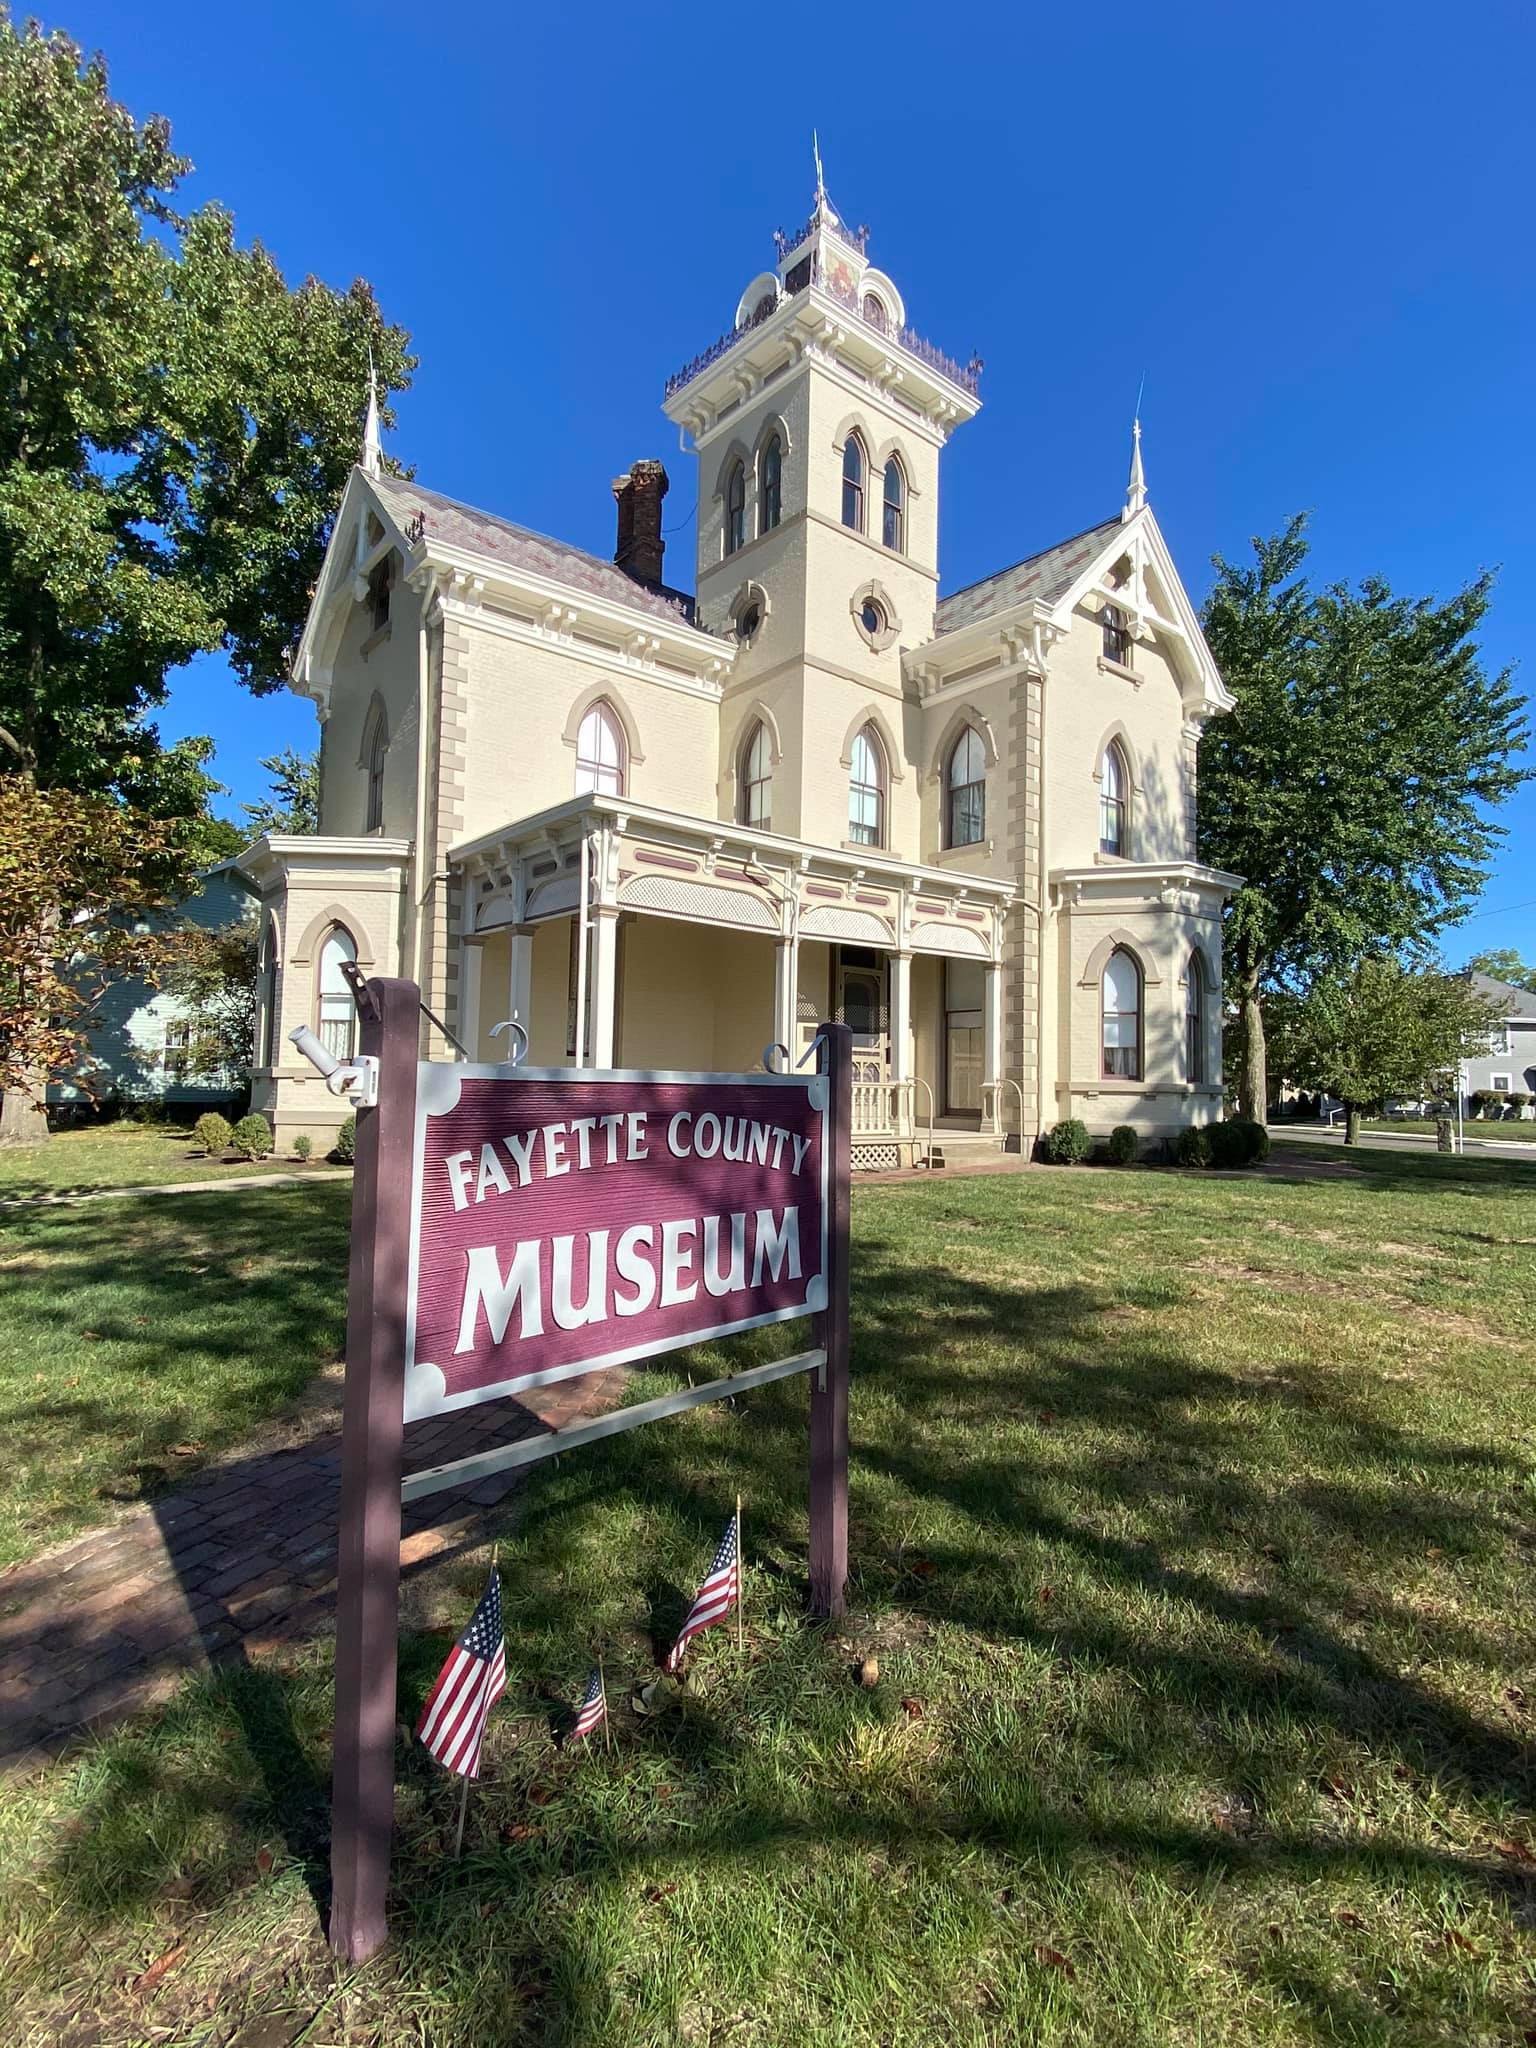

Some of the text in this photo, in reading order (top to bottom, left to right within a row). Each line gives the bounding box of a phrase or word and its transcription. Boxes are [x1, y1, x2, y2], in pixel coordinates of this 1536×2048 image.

[445, 1111, 812, 1212] FAYETTE COUNTY
[453, 1206, 803, 1355] MUSEUM
